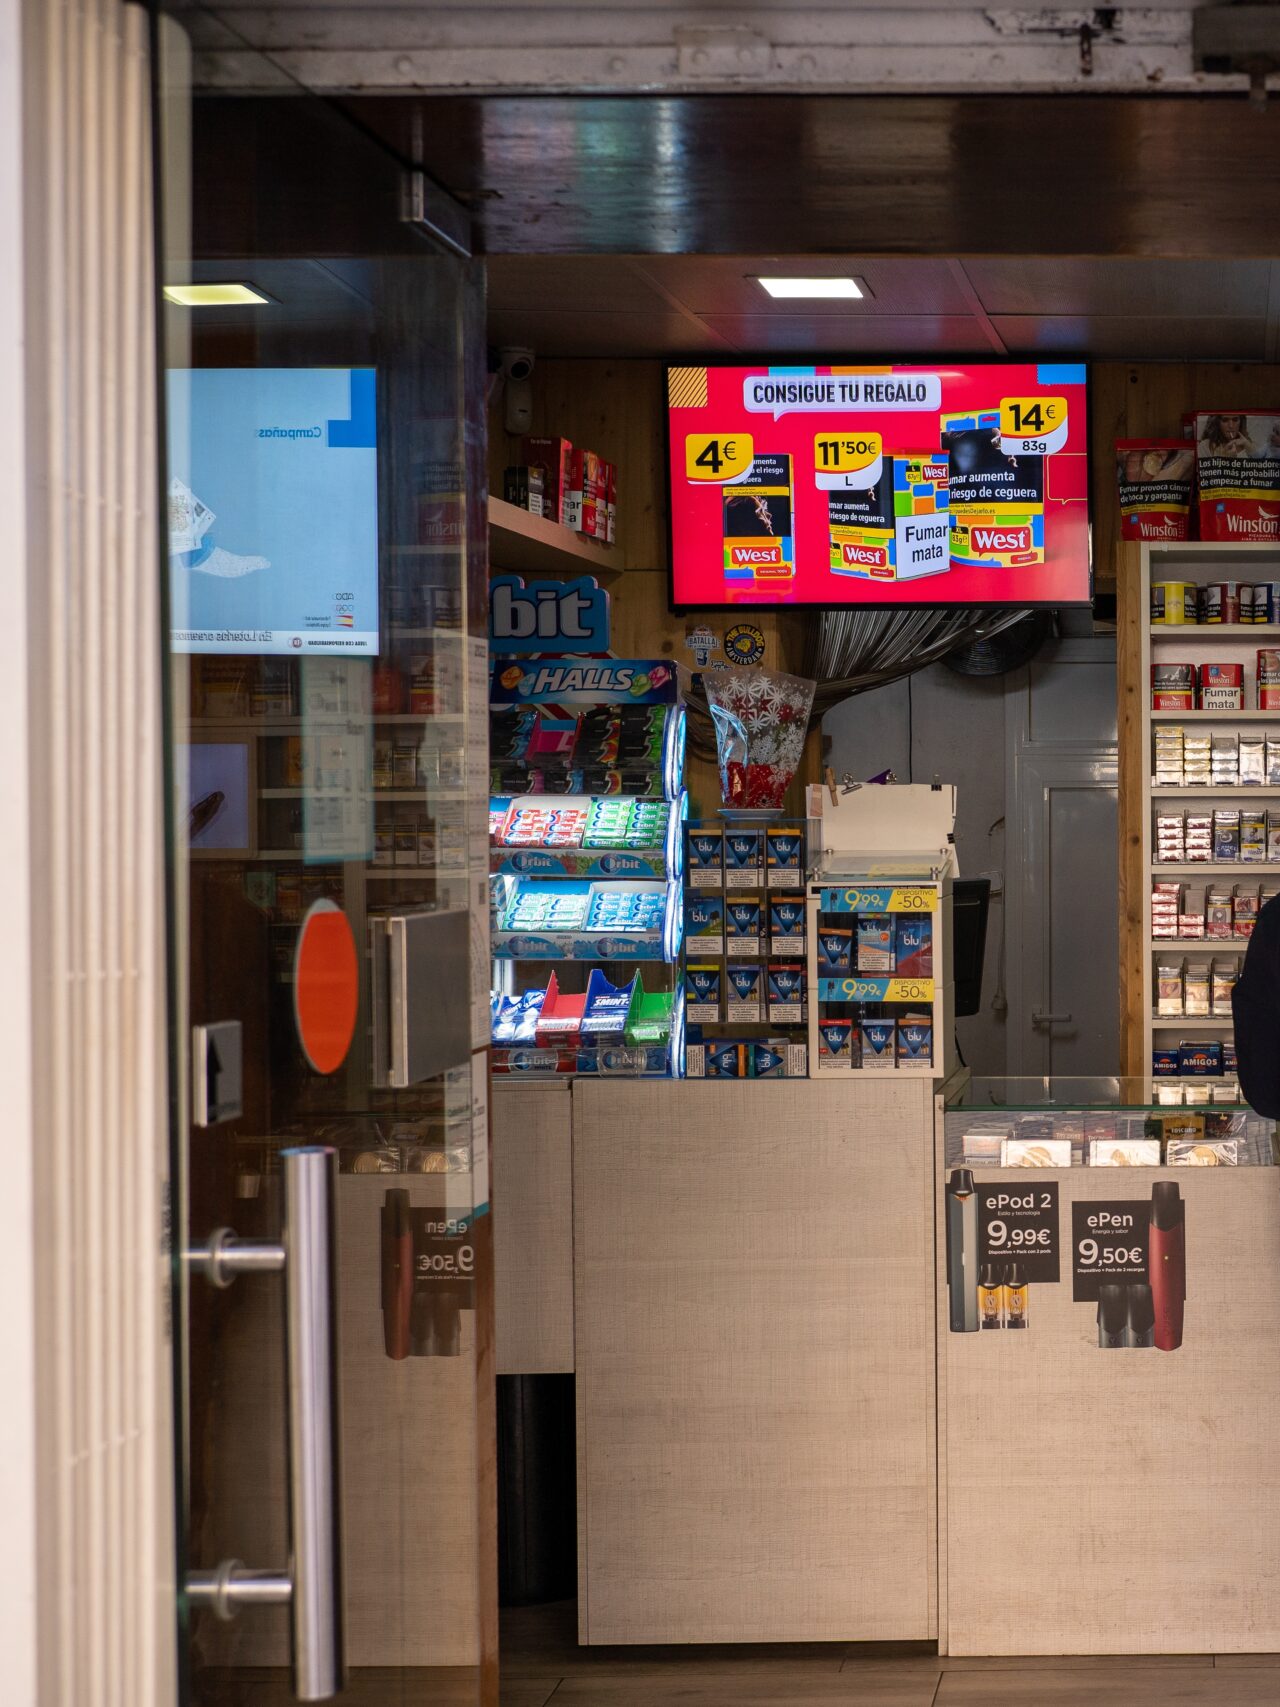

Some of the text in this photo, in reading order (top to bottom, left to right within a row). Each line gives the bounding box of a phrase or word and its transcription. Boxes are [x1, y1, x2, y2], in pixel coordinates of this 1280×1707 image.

[753, 383, 927, 404] CONSIGUE TU REGALO
[1009, 404, 1056, 432] 14€
[1022, 441, 1047, 453] 83g
[695, 440, 737, 474] 4€
[1199, 460, 1211, 468] Los
[1212, 458, 1230, 468] hijos
[1231, 459, 1241, 468] de
[763, 467, 784, 475] riesgo
[924, 466, 947, 478] West
[1199, 469, 1222, 477] tienen
[1223, 469, 1239, 477] más
[845, 476, 853, 486] L
[969, 471, 1015, 482] aumenta
[1140, 484, 1168, 493] provoca
[1169, 483, 1190, 492] cáncer
[1200, 479, 1209, 487] de
[1209, 478, 1241, 488] empezar
[1250, 478, 1273, 487] fumar
[951, 487, 1037, 500] riesgo de ceguera
[1144, 494, 1149, 502] y
[1150, 493, 1182, 502] garganta
[844, 503, 869, 511] aumenta
[858, 515, 885, 524] ceguera
[1226, 514, 1278, 533] Winston
[905, 525, 948, 543] Fumar
[1140, 523, 1178, 537] Winston
[975, 530, 1025, 549] West
[735, 548, 777, 562] West
[845, 547, 882, 564] West
[912, 545, 943, 562] mata
[688, 636, 715, 646] BATALLA
[727, 625, 764, 647] THE BULLDOG
[726, 647, 762, 665] AMSTERDAM
[532, 668, 634, 694] HALLS
[1204, 688, 1239, 697] Fumar
[1207, 700, 1235, 709] mata
[698, 842, 712, 851] blu
[734, 842, 748, 851] blu
[776, 842, 790, 850] blu
[511, 851, 553, 873] Orbit
[599, 852, 640, 874] Orbit
[898, 895, 930, 908] -50%
[692, 912, 708, 922] blu
[736, 910, 750, 919] blu
[780, 909, 794, 918] blu
[828, 942, 842, 950] blu
[904, 936, 918, 946] blu
[696, 977, 710, 986] blu
[736, 978, 750, 986] blu
[778, 977, 792, 986] blu
[895, 985, 927, 998] -50%
[594, 998, 625, 1007] SMINT
[828, 1032, 842, 1041] blu
[872, 1032, 886, 1041] blu
[908, 1031, 922, 1040] blu
[1183, 1058, 1218, 1066] AMIGOS
[986, 1193, 1052, 1209] ePod 2
[1087, 1212, 1133, 1227] ePen
[987, 1220, 1051, 1248] 9,99€
[1078, 1238, 1143, 1267] 9,50€
